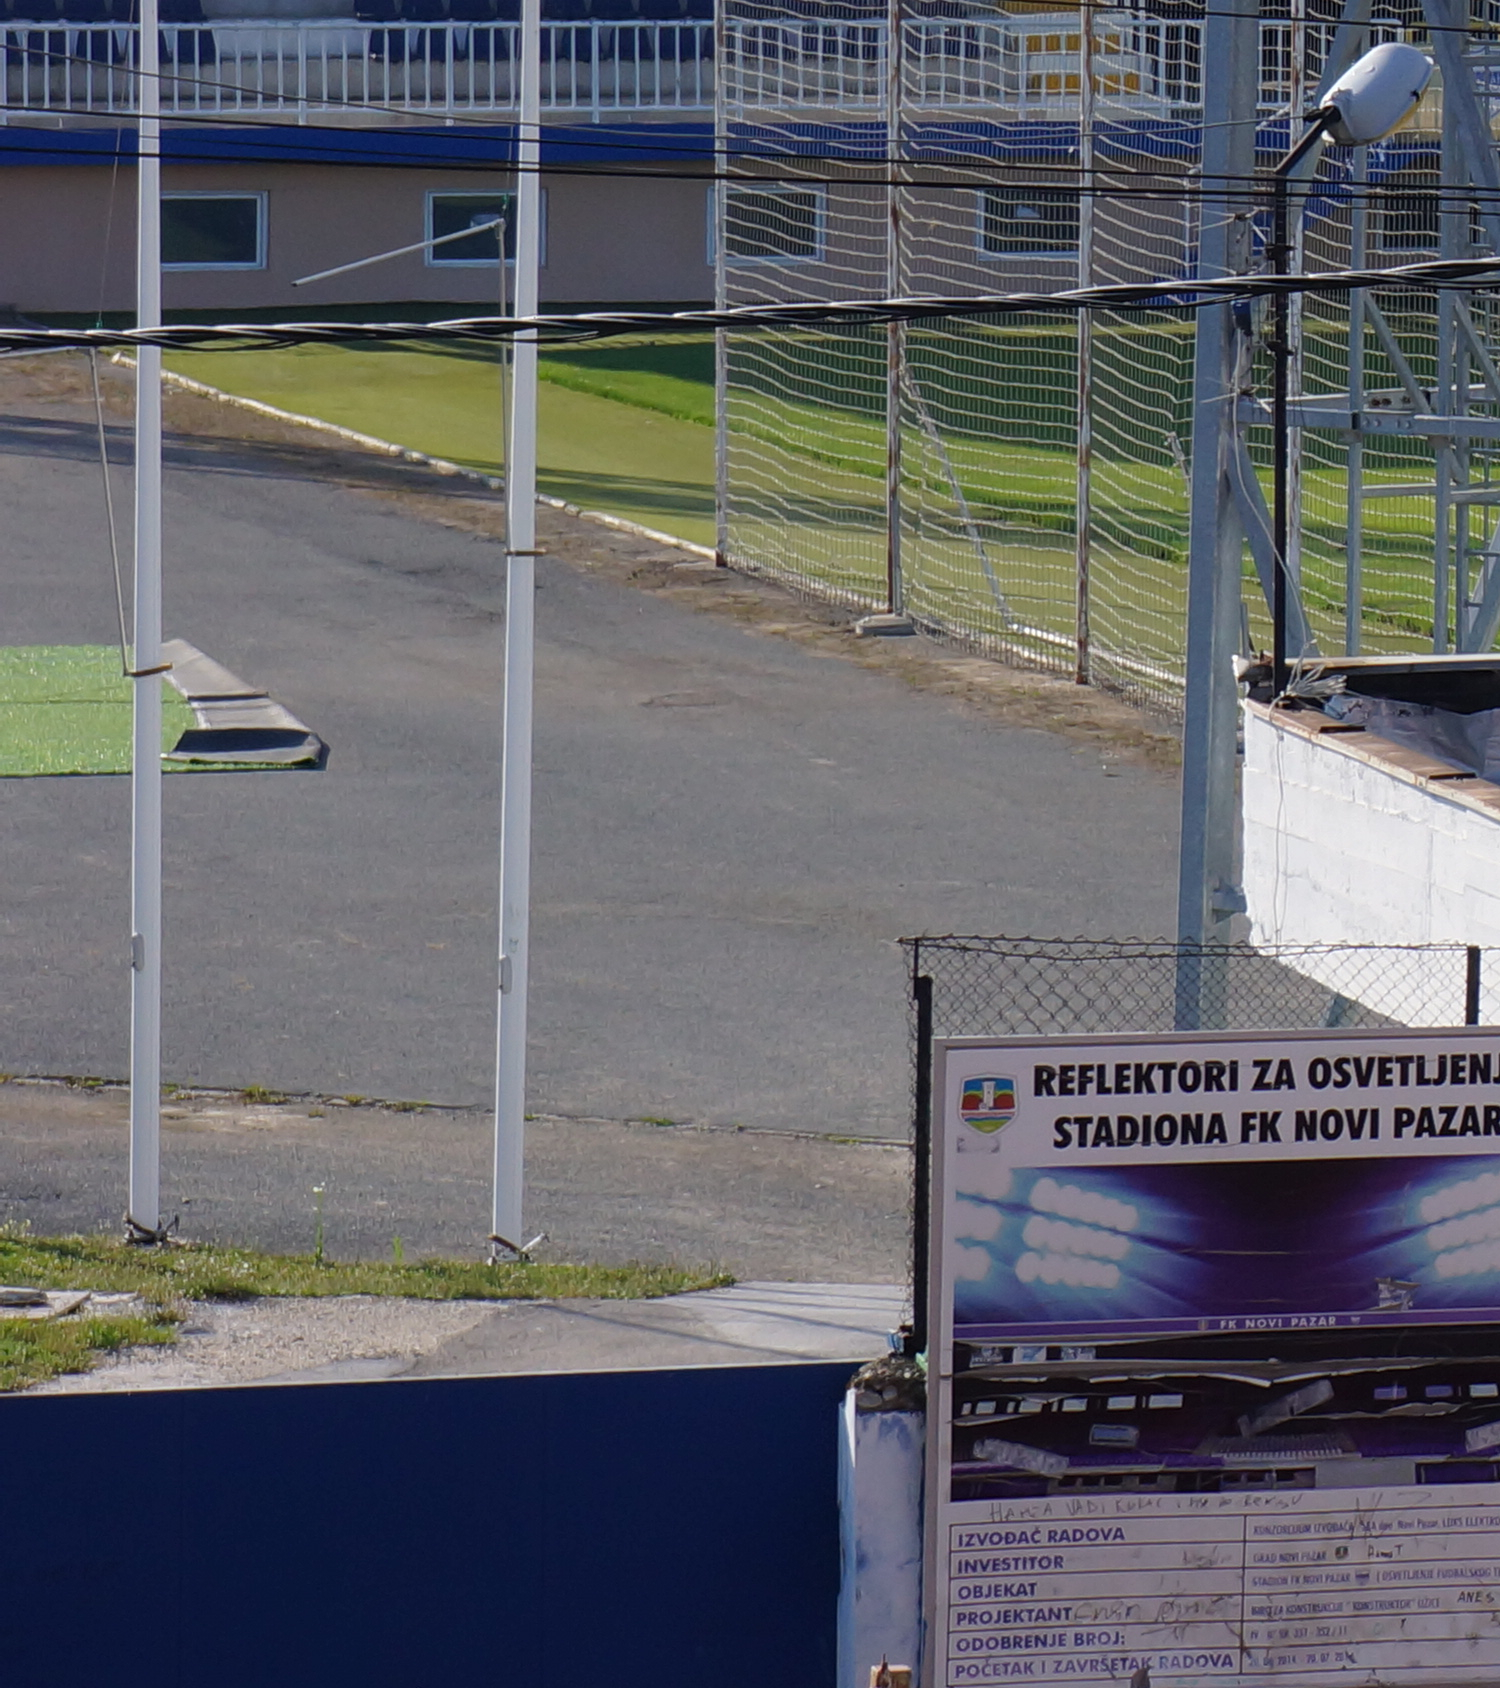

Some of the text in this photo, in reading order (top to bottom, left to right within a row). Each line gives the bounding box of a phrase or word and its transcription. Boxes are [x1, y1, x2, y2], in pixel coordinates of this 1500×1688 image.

[1032, 1057, 1242, 1097] REFLEKTORI
[1250, 1056, 1296, 1093] ZA
[1052, 1111, 1227, 1149] STADIONA
[1240, 1109, 1284, 1145] FK
[1294, 1107, 1380, 1143] NOVI
[1219, 1314, 1338, 1330] FK NOVI PAZAR
[957, 1526, 1126, 1548] IZVOĐAČ RADOVA
[957, 1555, 1065, 1574] INVESTITOR
[957, 1582, 1038, 1600] OBJEKAT
[956, 1607, 1073, 1626] PROJEKTANT
[956, 1627, 1126, 1652] ODOBRENJE BROJ:
[954, 1656, 1035, 1679] POČETAK
[1040, 1660, 1046, 1675] I
[1052, 1654, 1154, 1675] ZAVRŠETAK
[1159, 1653, 1234, 1670] RADOVA
